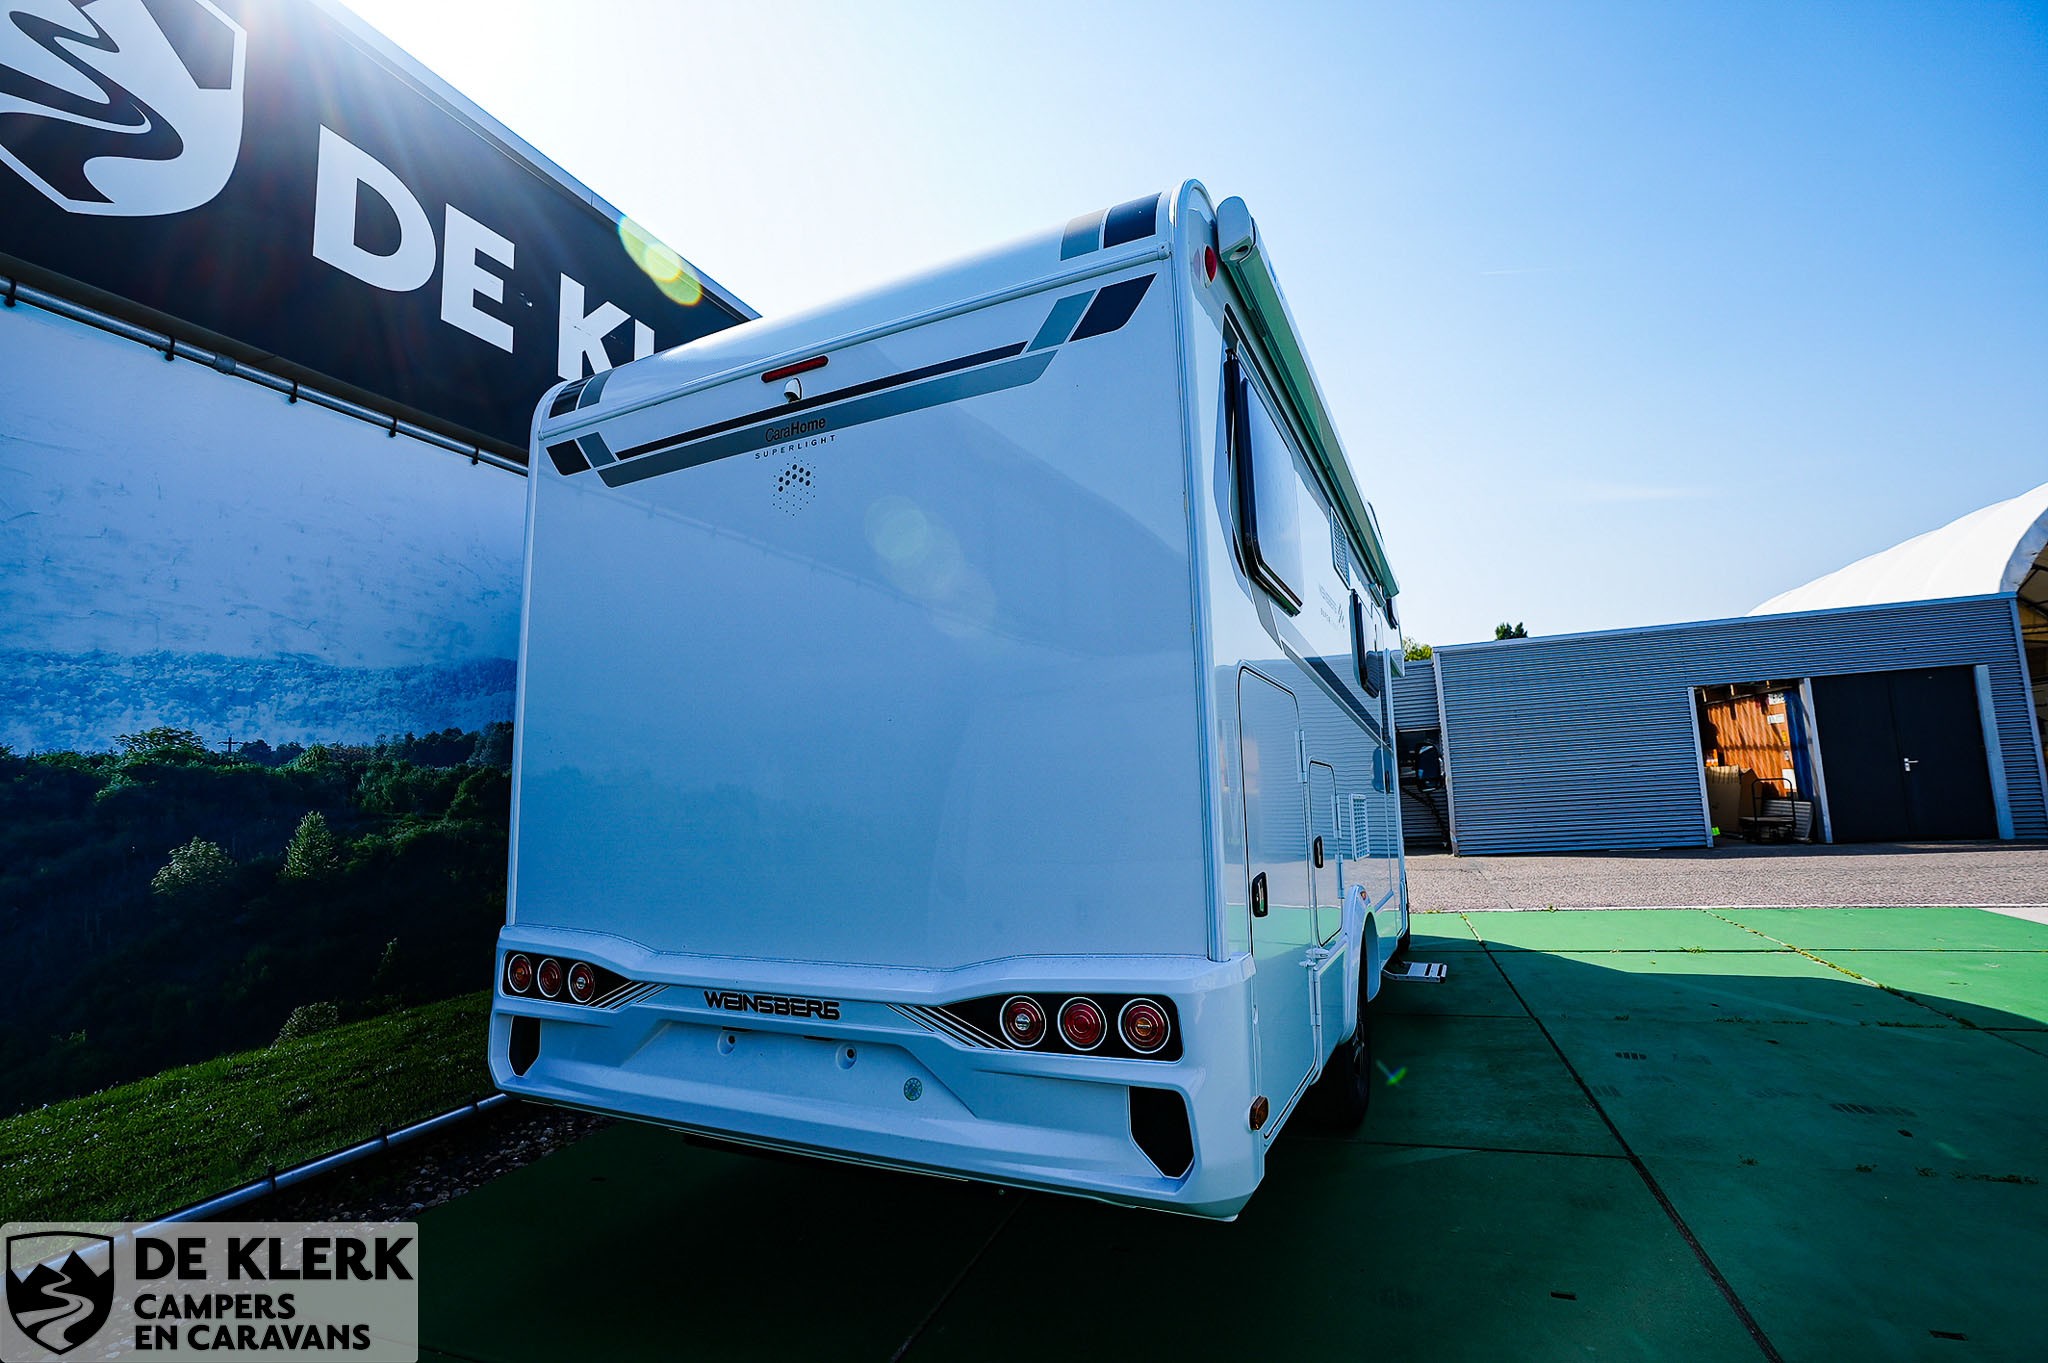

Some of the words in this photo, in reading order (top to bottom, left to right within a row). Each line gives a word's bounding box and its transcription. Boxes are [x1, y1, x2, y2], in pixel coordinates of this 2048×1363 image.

[312, 123, 516, 354] DE
[765, 417, 826, 442] CaraHome
[754, 434, 836, 460] SUPERLIGHT
[703, 990, 841, 1020] WEINSBERG
